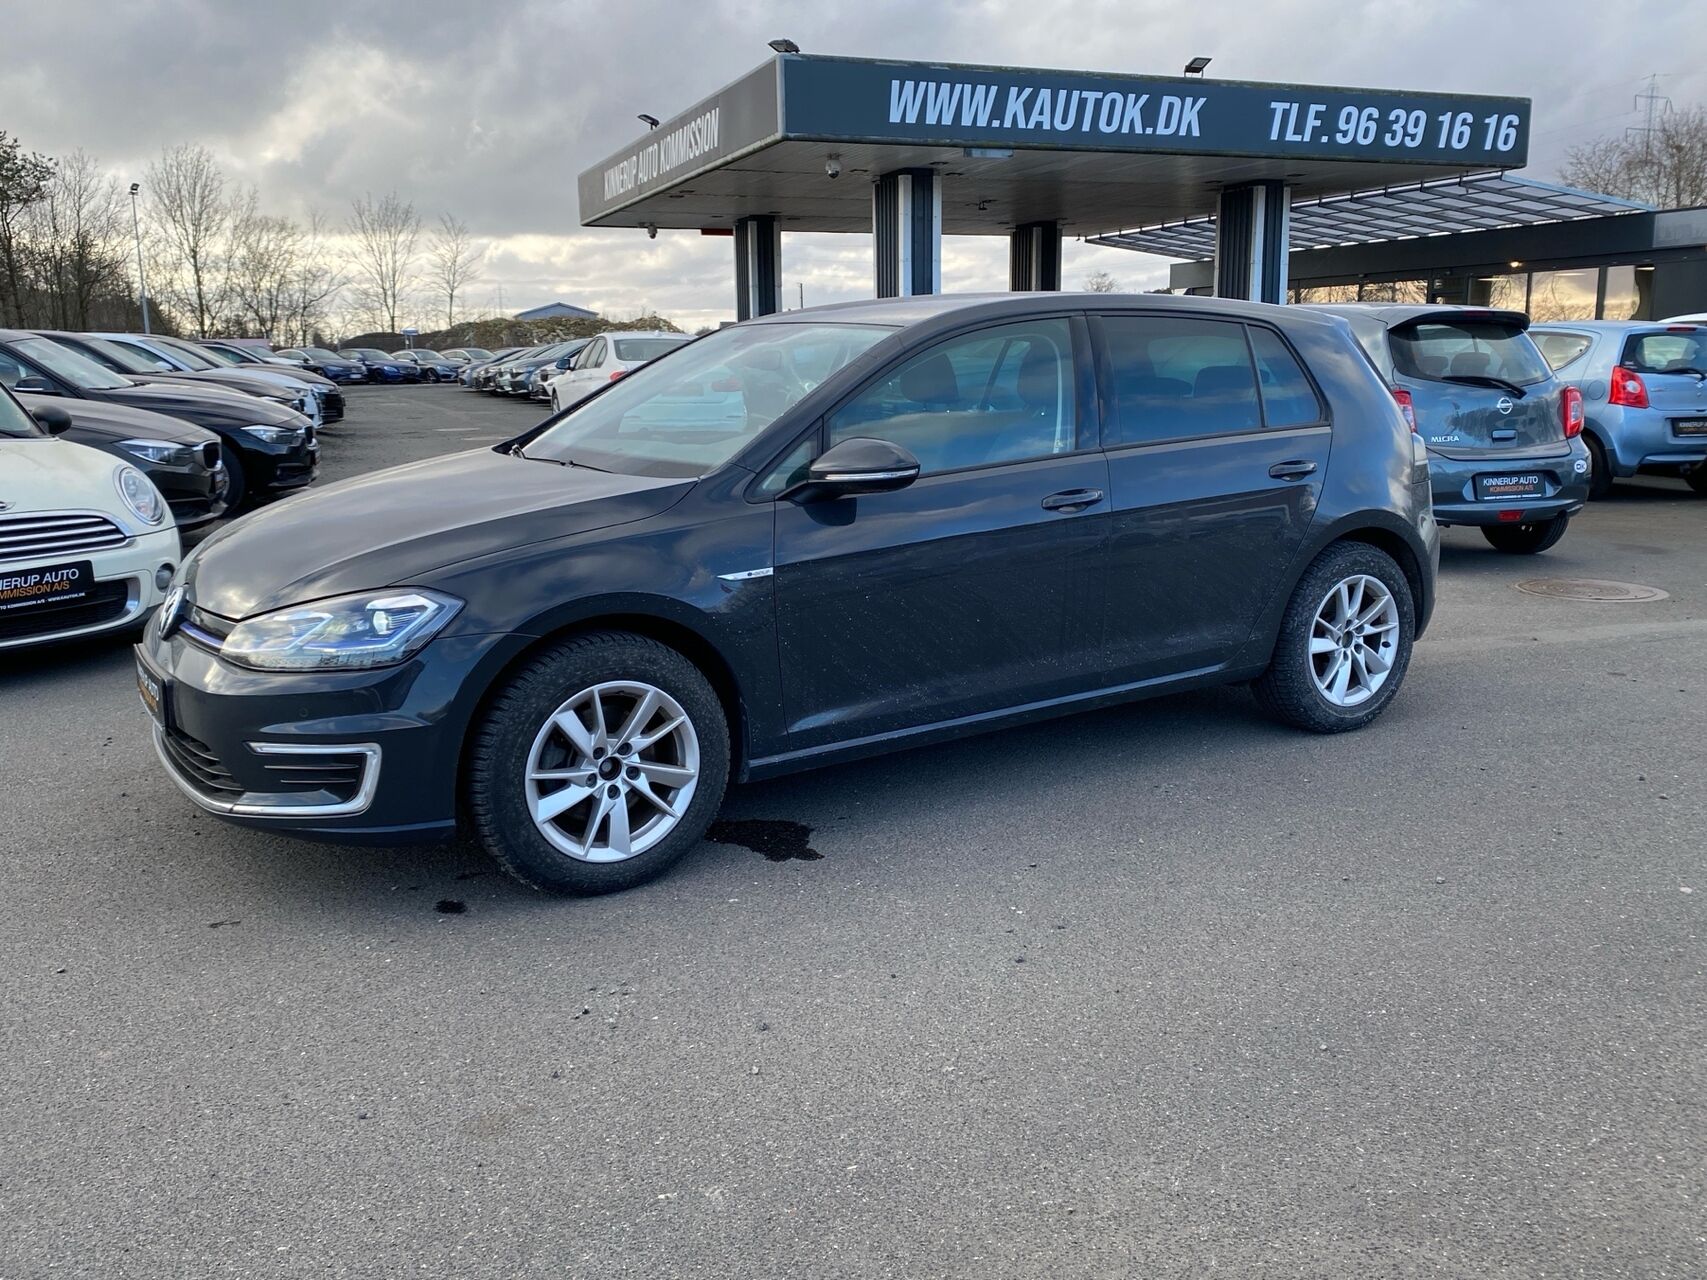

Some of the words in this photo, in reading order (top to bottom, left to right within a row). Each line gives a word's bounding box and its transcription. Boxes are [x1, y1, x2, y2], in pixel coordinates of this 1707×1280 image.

[889, 79, 1207, 137] WWW.KAUTOK.DK
[1270, 101, 1329, 143] TLF.
[1335, 105, 1380, 146] 96
[1384, 108, 1427, 148] 39
[1437, 111, 1474, 150] 16
[1484, 114, 1520, 151] 16
[604, 155, 638, 201] KINNERUP
[637, 143, 659, 185] AUTO
[660, 107, 719, 174] KOMMISSION
[1431, 435, 1460, 443] MICRA
[1483, 477, 1519, 486] KINNERUP
[1519, 476, 1539, 485] AUTO
[0, 574, 40, 590] ERUP
[42, 568, 79, 584] AUTO
[52, 581, 70, 591] A/S
